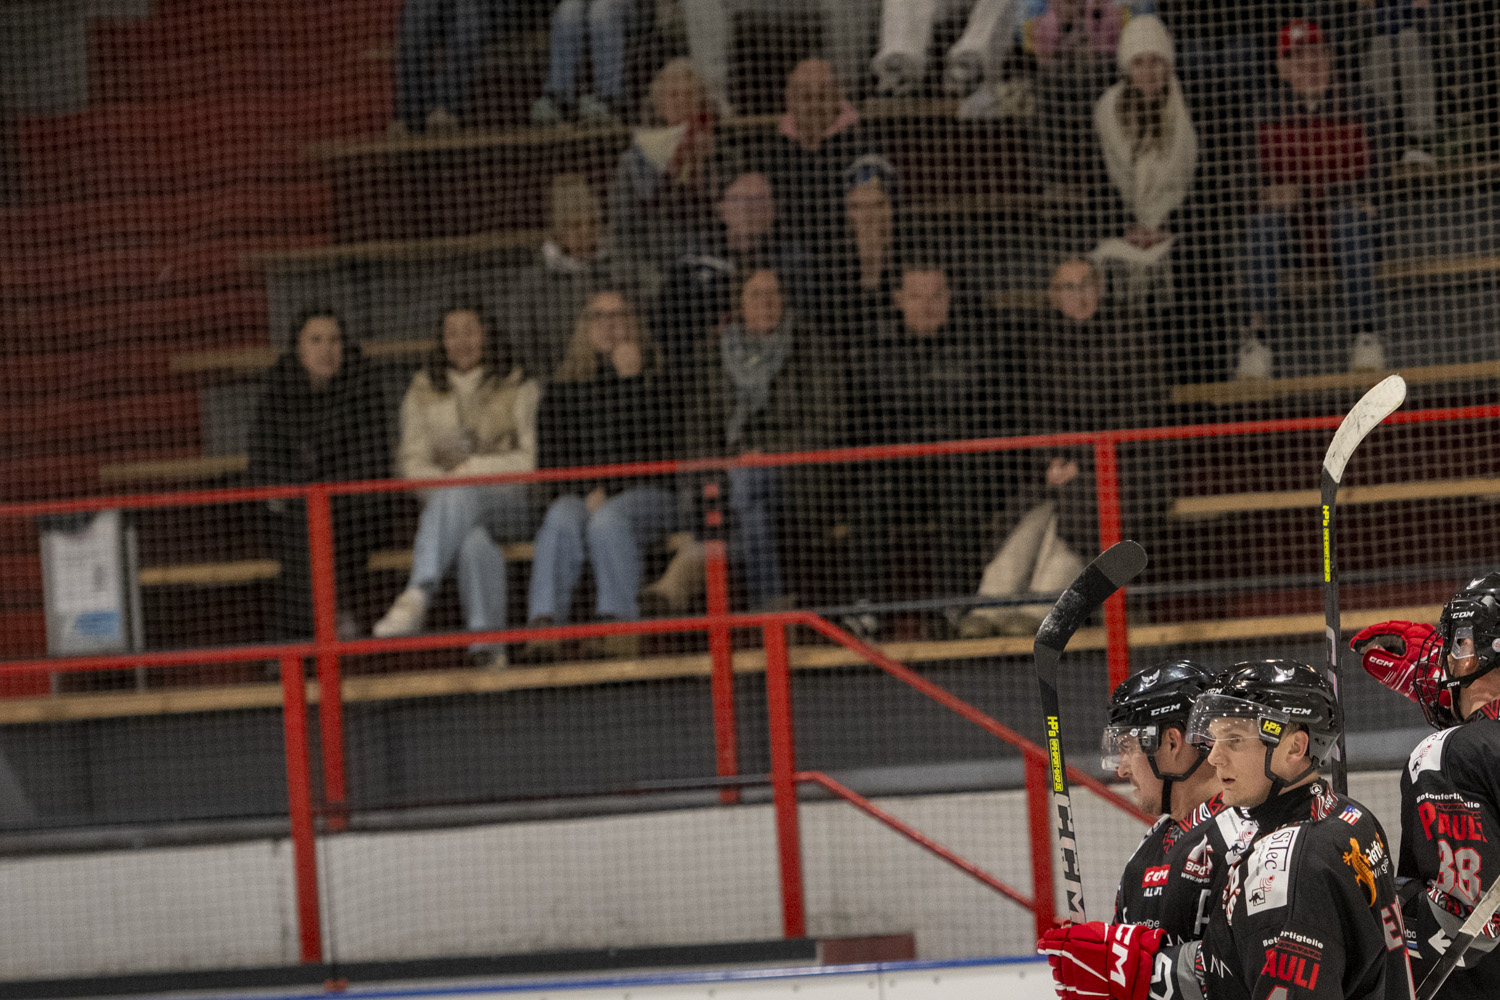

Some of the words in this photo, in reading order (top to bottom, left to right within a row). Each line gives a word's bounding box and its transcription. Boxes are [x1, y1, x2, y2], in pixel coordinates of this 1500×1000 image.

[1368, 655, 1395, 668] CCM
[1151, 703, 1181, 717] CCM
[1282, 706, 1312, 716] CCM
[1261, 948, 1320, 990] AULI
